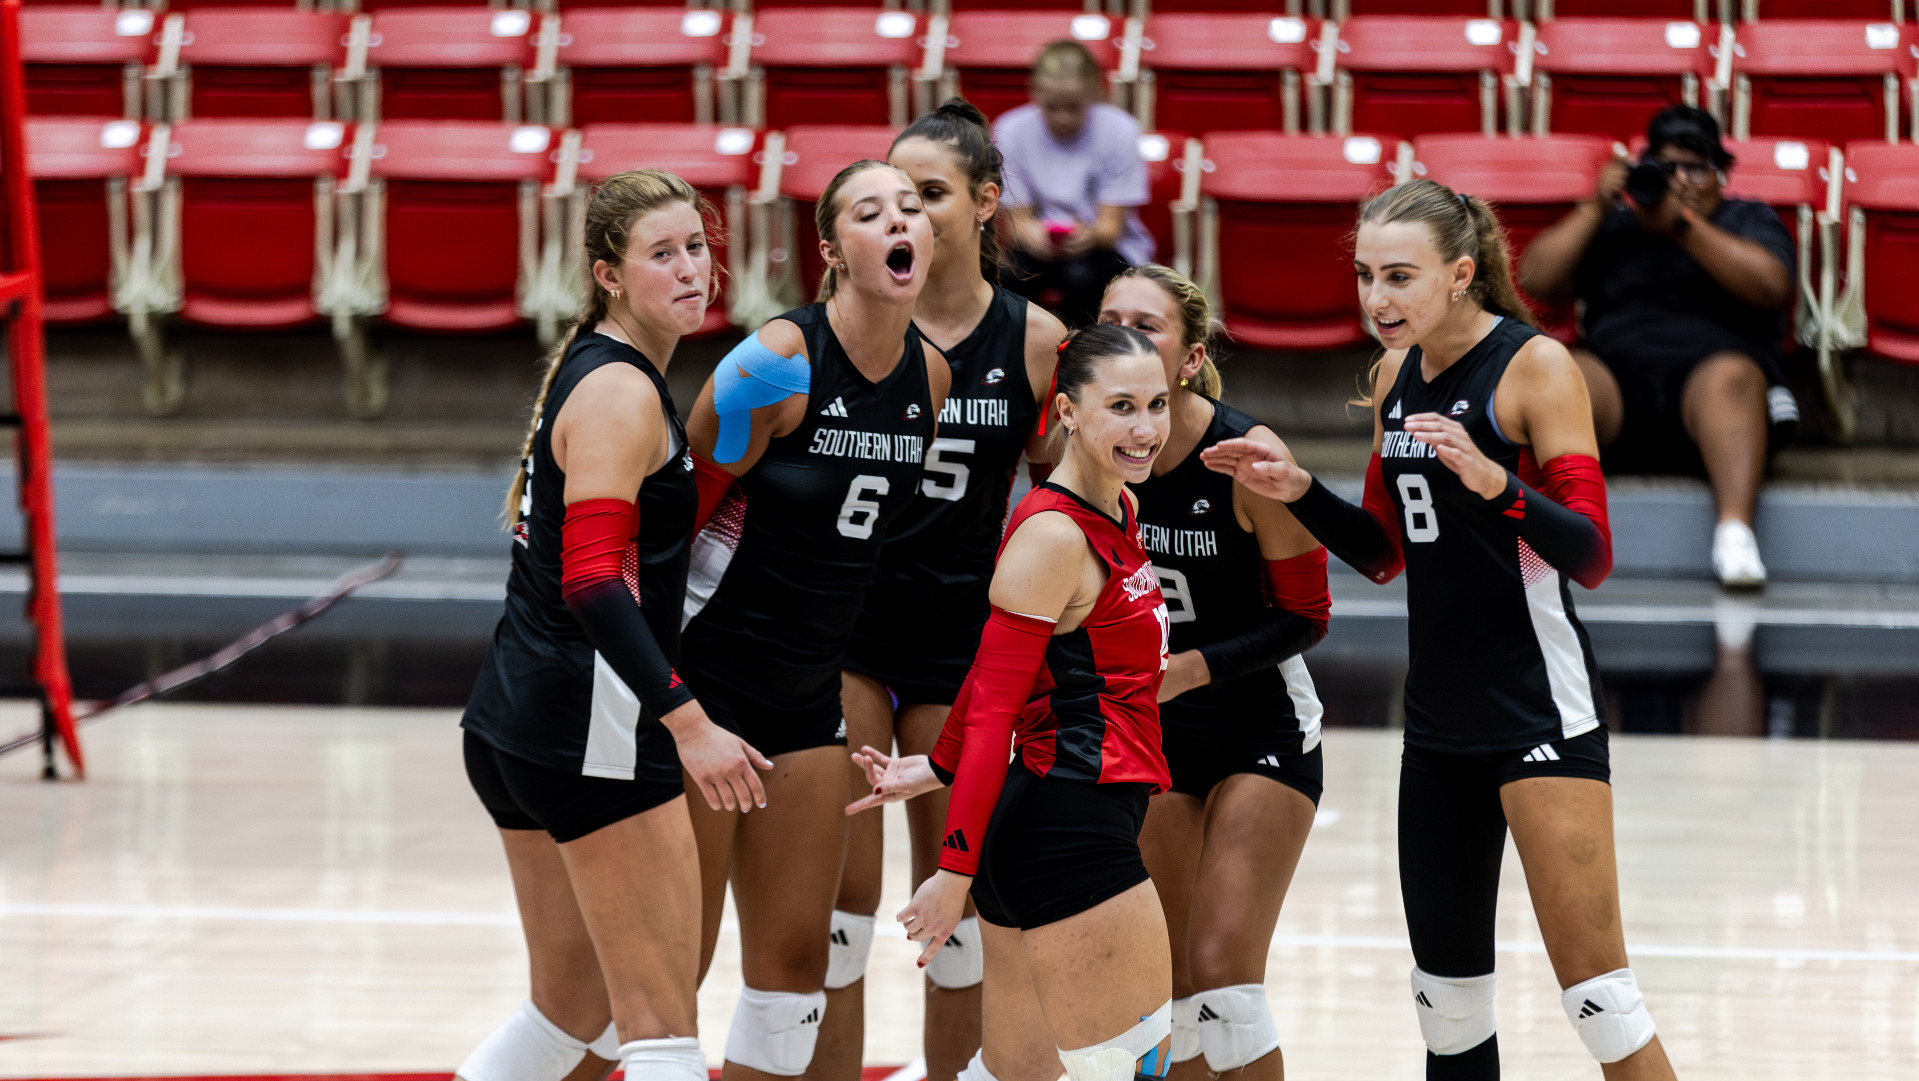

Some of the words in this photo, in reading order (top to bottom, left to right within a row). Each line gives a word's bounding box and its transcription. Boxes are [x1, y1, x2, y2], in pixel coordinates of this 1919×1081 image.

[966, 398, 1008, 427] UTAH
[808, 428, 891, 462] SOUTHERN
[894, 434, 923, 464] UTAH
[836, 474, 890, 540] 6
[1396, 473, 1440, 543] 8
[1174, 528, 1218, 557] UTAH
